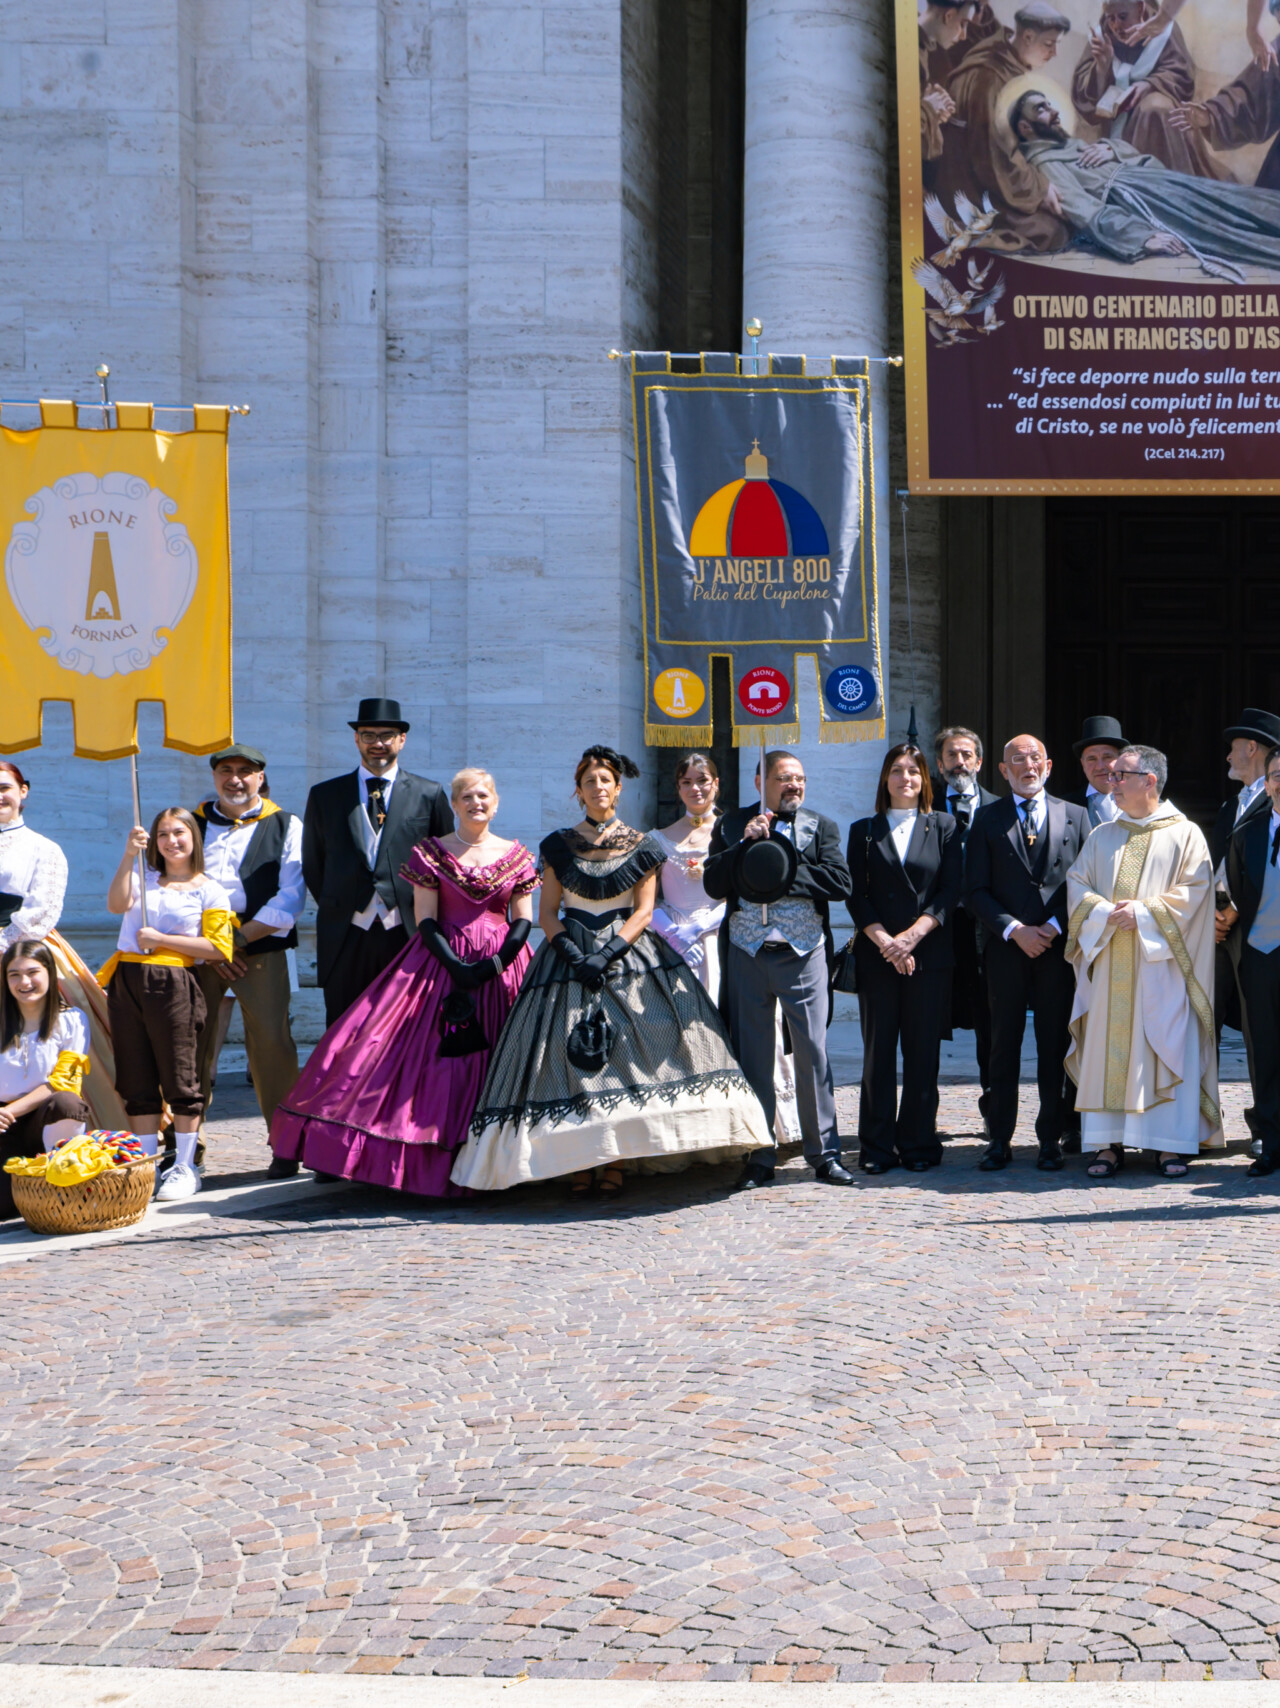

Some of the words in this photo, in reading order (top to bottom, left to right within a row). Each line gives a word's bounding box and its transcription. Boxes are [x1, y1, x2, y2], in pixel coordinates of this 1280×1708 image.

[1013, 295, 1088, 318] OTTAVO
[1093, 295, 1217, 318] CENTENARIO
[1221, 294, 1279, 318] DELLA
[1044, 327, 1065, 350] DI
[1069, 327, 1109, 350] SAN
[1114, 327, 1230, 350] FRANCESCO
[1037, 368, 1076, 388] fece
[1080, 368, 1149, 388] deporre
[1153, 368, 1199, 384] nudo
[1204, 368, 1246, 384] sulla
[1042, 394, 1127, 409] essendosi
[1131, 394, 1212, 413] compiuti
[1216, 394, 1233, 409] in
[1237, 393, 1260, 409] lui
[1015, 418, 1033, 434] di
[1037, 419, 1094, 436] Cristo,
[1100, 422, 1118, 434] se
[1122, 422, 1143, 434] ne
[1147, 418, 1185, 434] volò
[1144, 448, 1175, 460] (2Cel
[1177, 448, 1225, 461] 214.217)
[68, 508, 138, 529] RIONE
[793, 558, 831, 583] 800
[693, 583, 729, 601] Palio
[734, 583, 758, 600] del
[762, 582, 831, 609] Cupolone
[71, 623, 139, 643] FORNACI
[666, 671, 690, 679] RIONE
[838, 668, 860, 676] RIONE
[747, 703, 765, 714] PONTE
[766, 702, 783, 714] ROSSO
[837, 702, 848, 711] DEL
[848, 700, 867, 711] CAMPO
